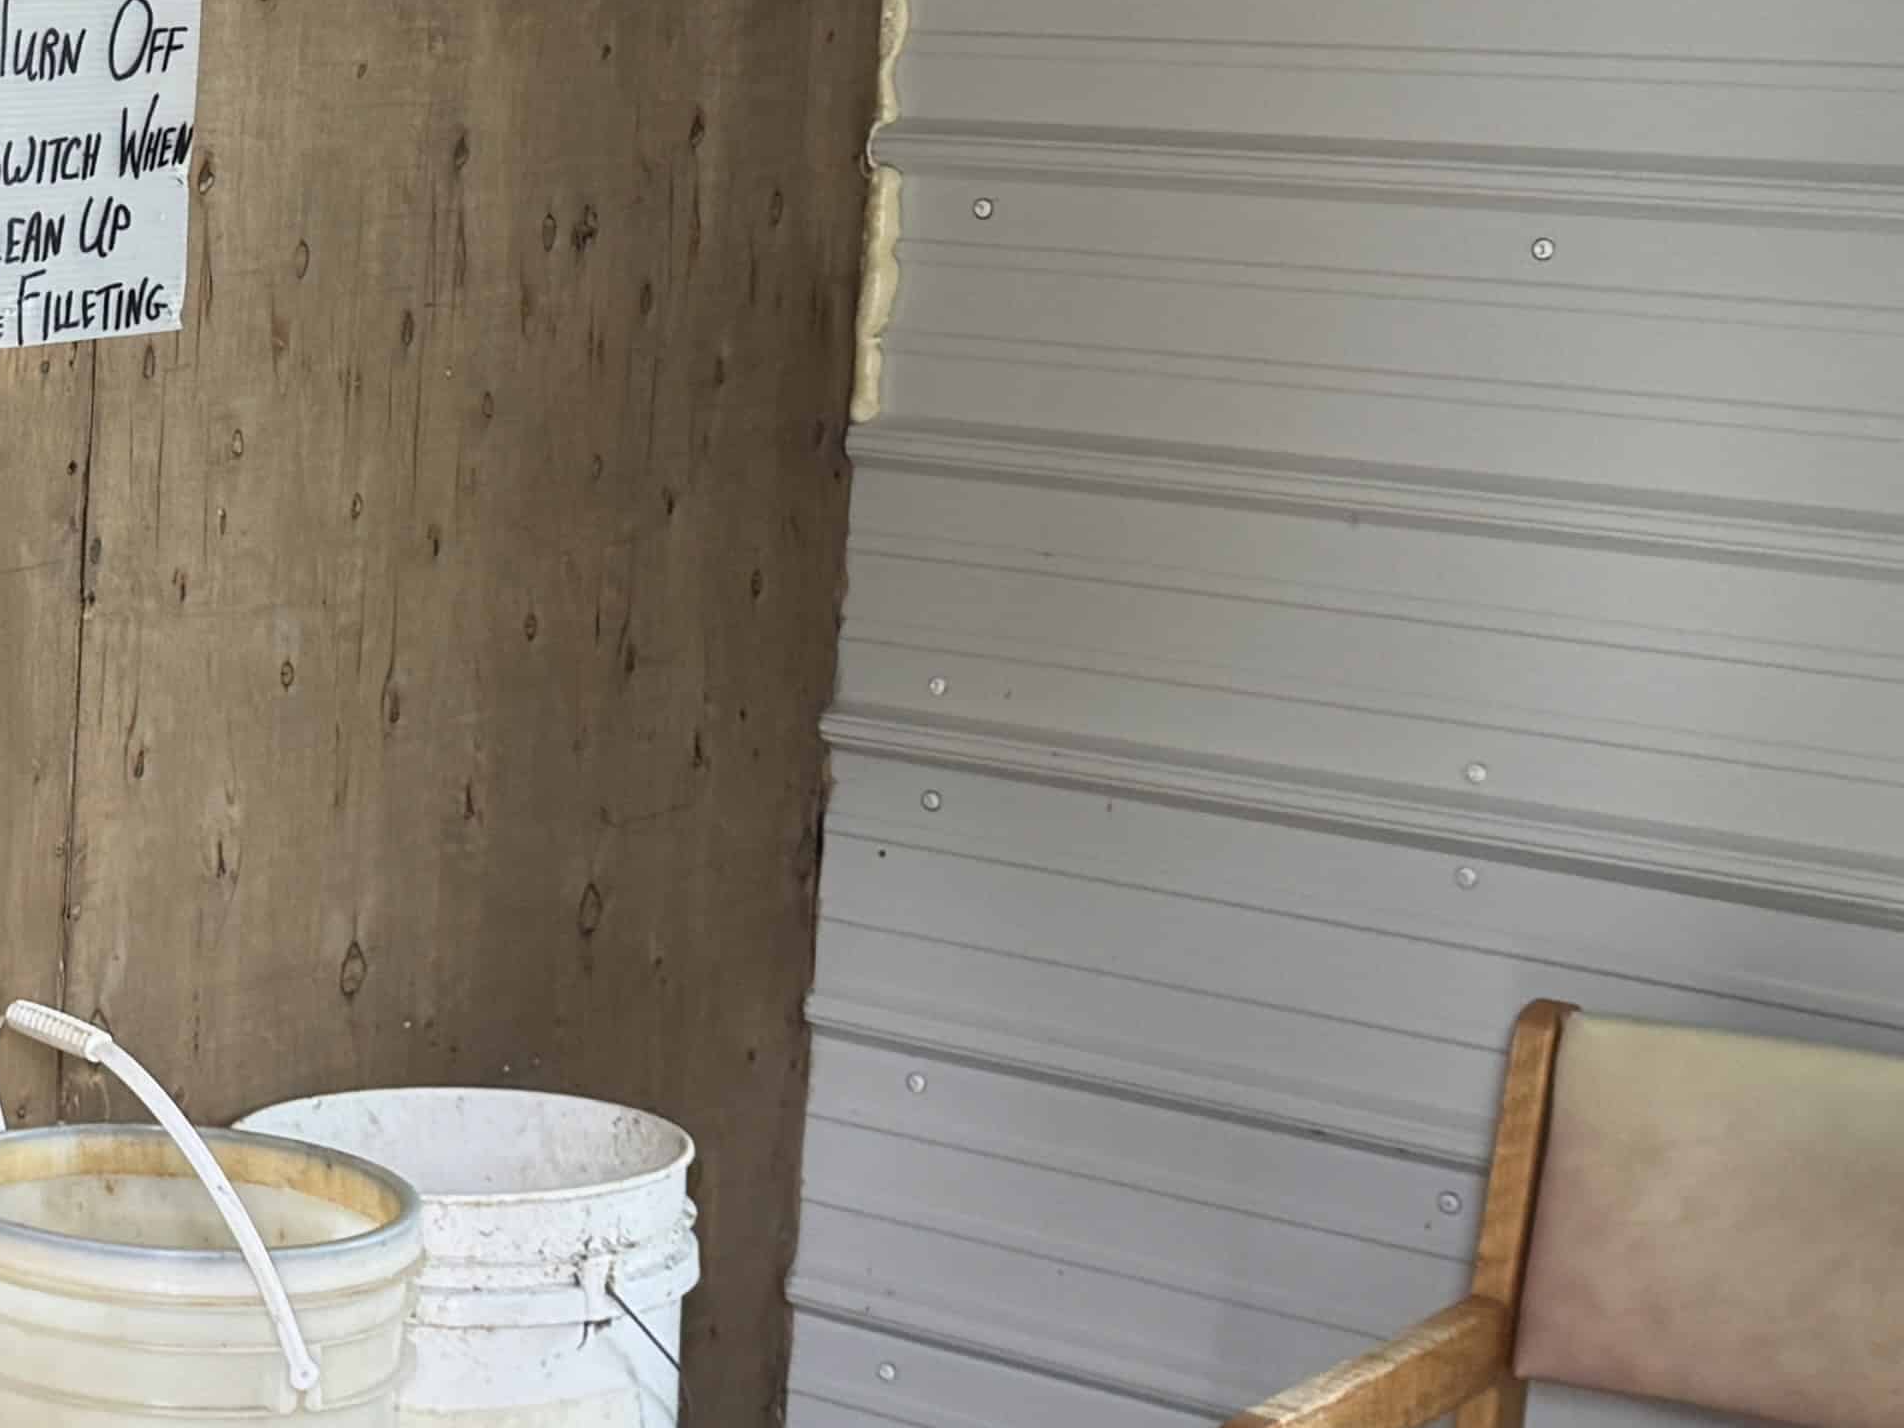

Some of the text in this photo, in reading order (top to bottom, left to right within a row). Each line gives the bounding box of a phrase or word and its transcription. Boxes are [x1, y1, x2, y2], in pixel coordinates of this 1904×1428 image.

[118, 92, 194, 180] WHEN
[79, 195, 132, 258] UP
[17, 269, 170, 347] FILLETING
